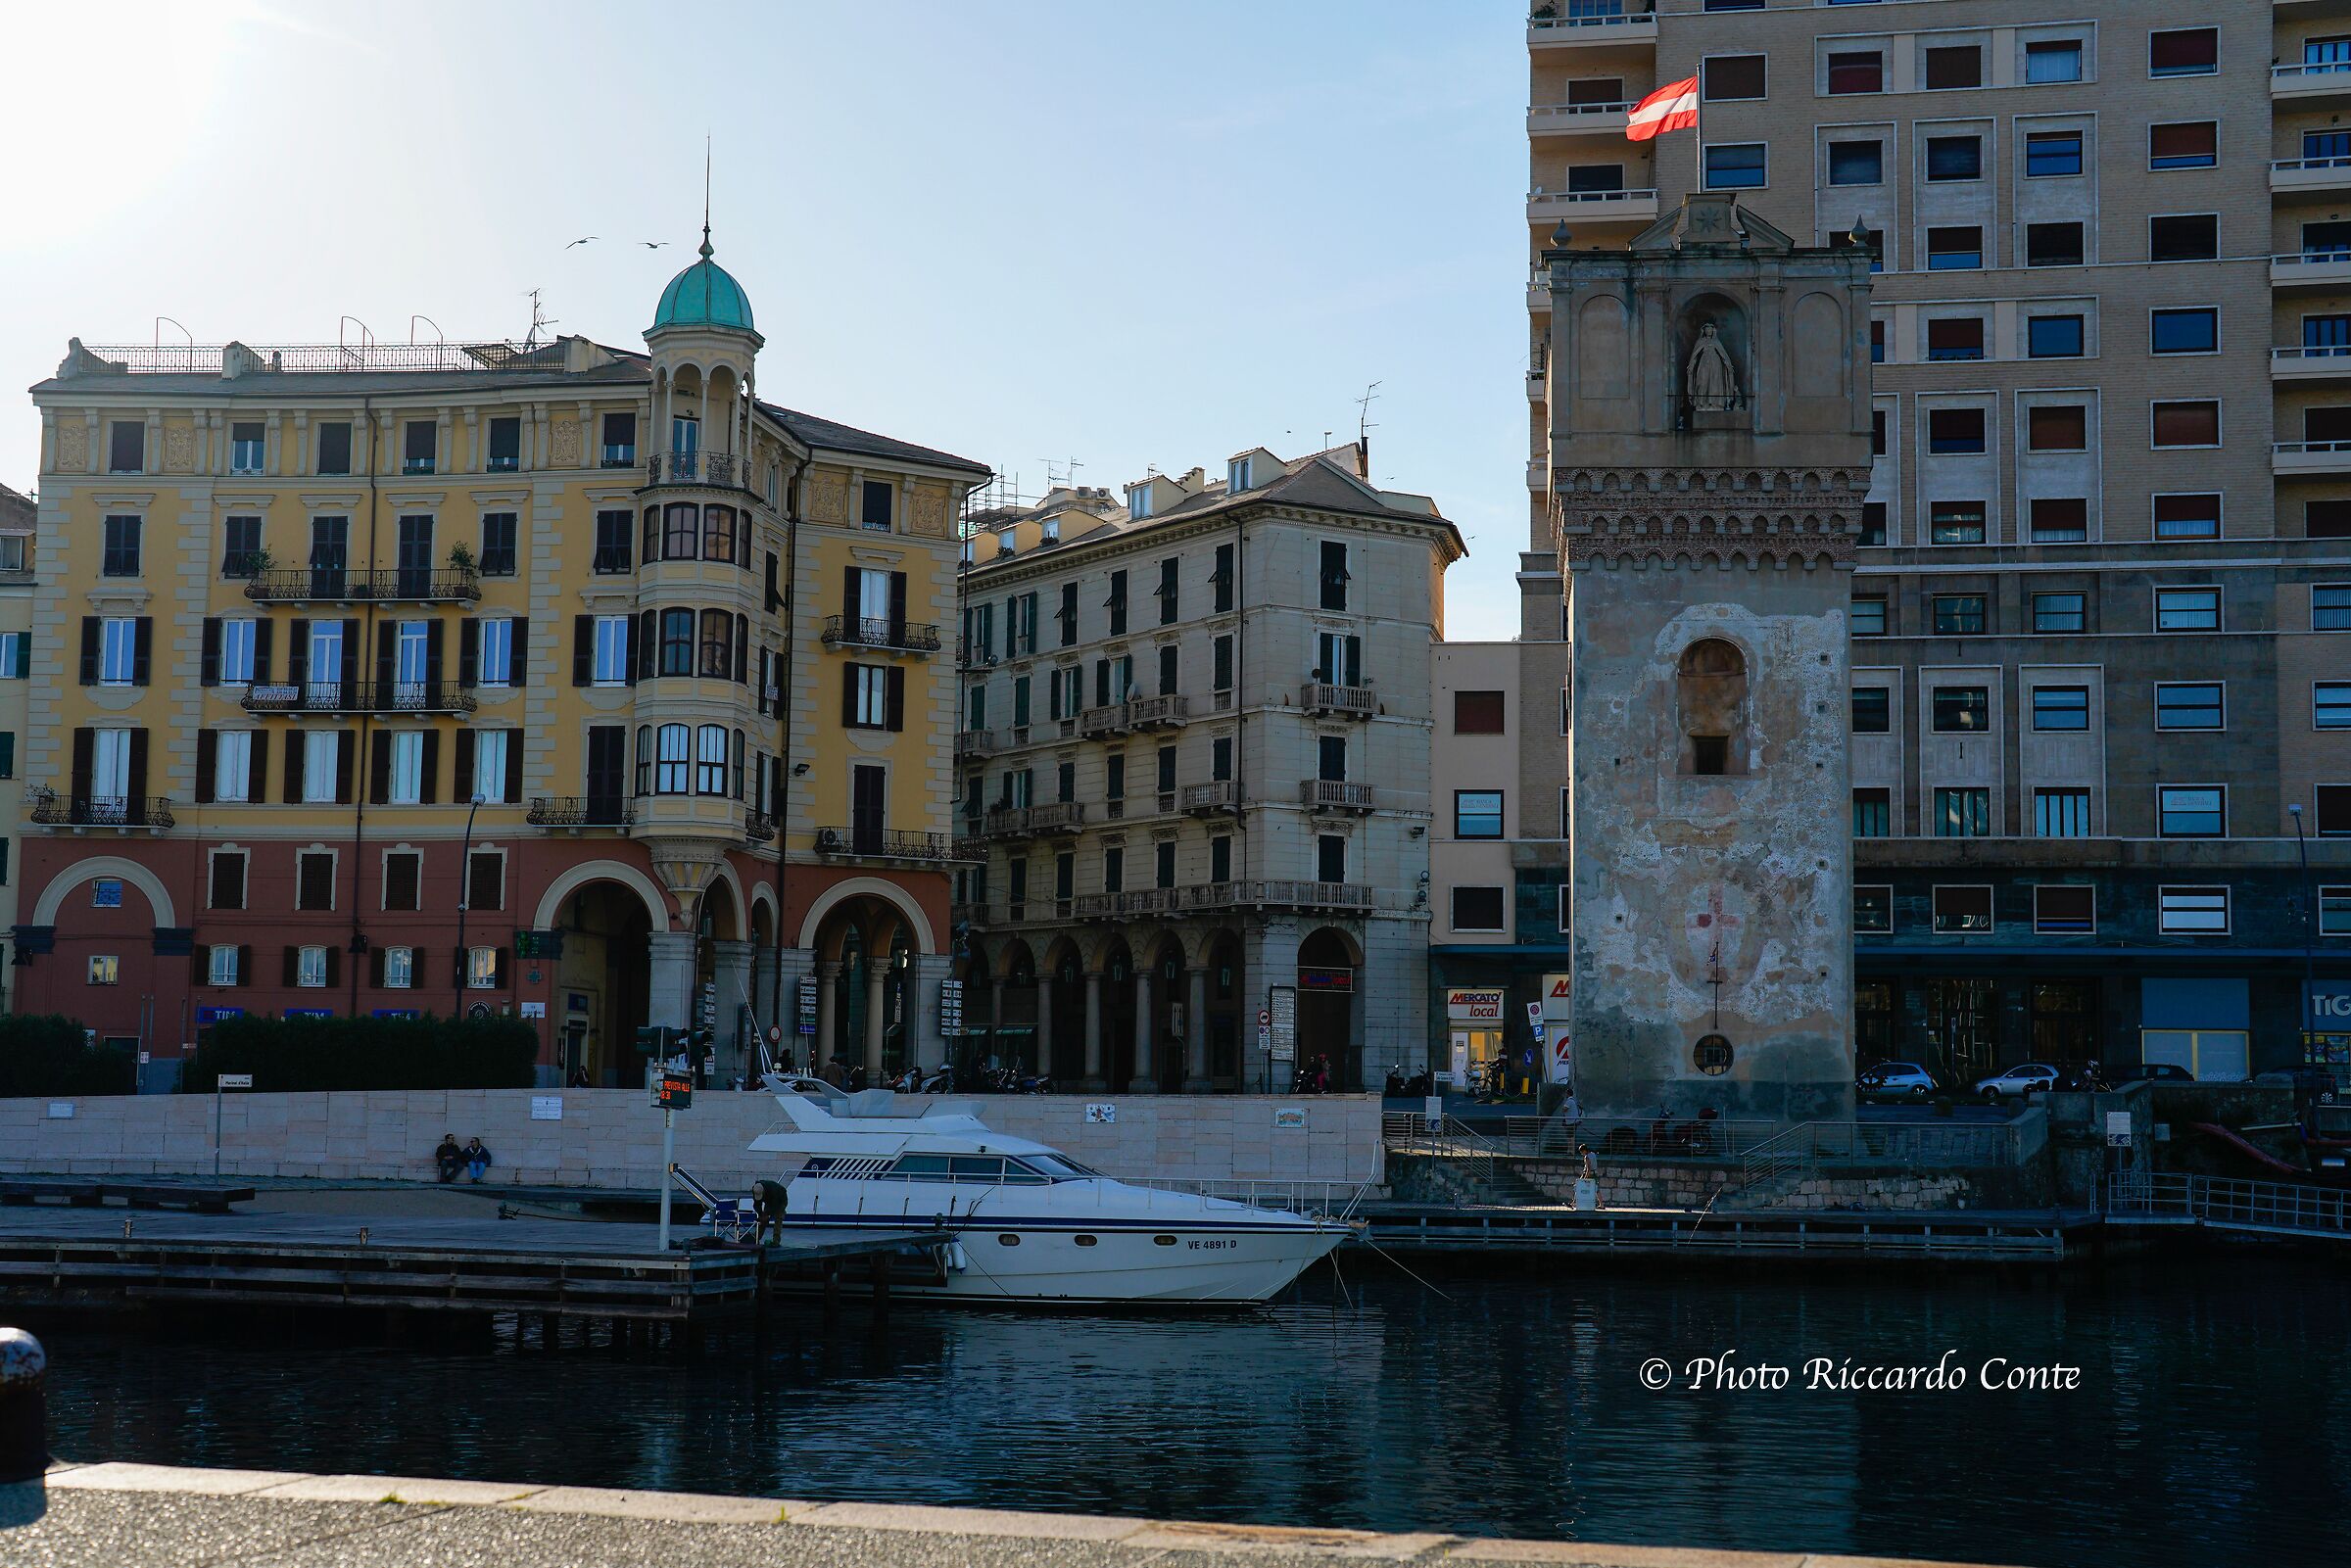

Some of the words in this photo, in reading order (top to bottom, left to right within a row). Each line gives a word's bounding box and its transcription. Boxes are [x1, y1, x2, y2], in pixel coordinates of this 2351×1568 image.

[215, 1010, 236, 1020] TIM
[1469, 1004, 1499, 1017] local
[1187, 1240, 1200, 1250] VE
[1203, 1240, 1226, 1250] 4891
[1230, 1240, 1237, 1249] D
